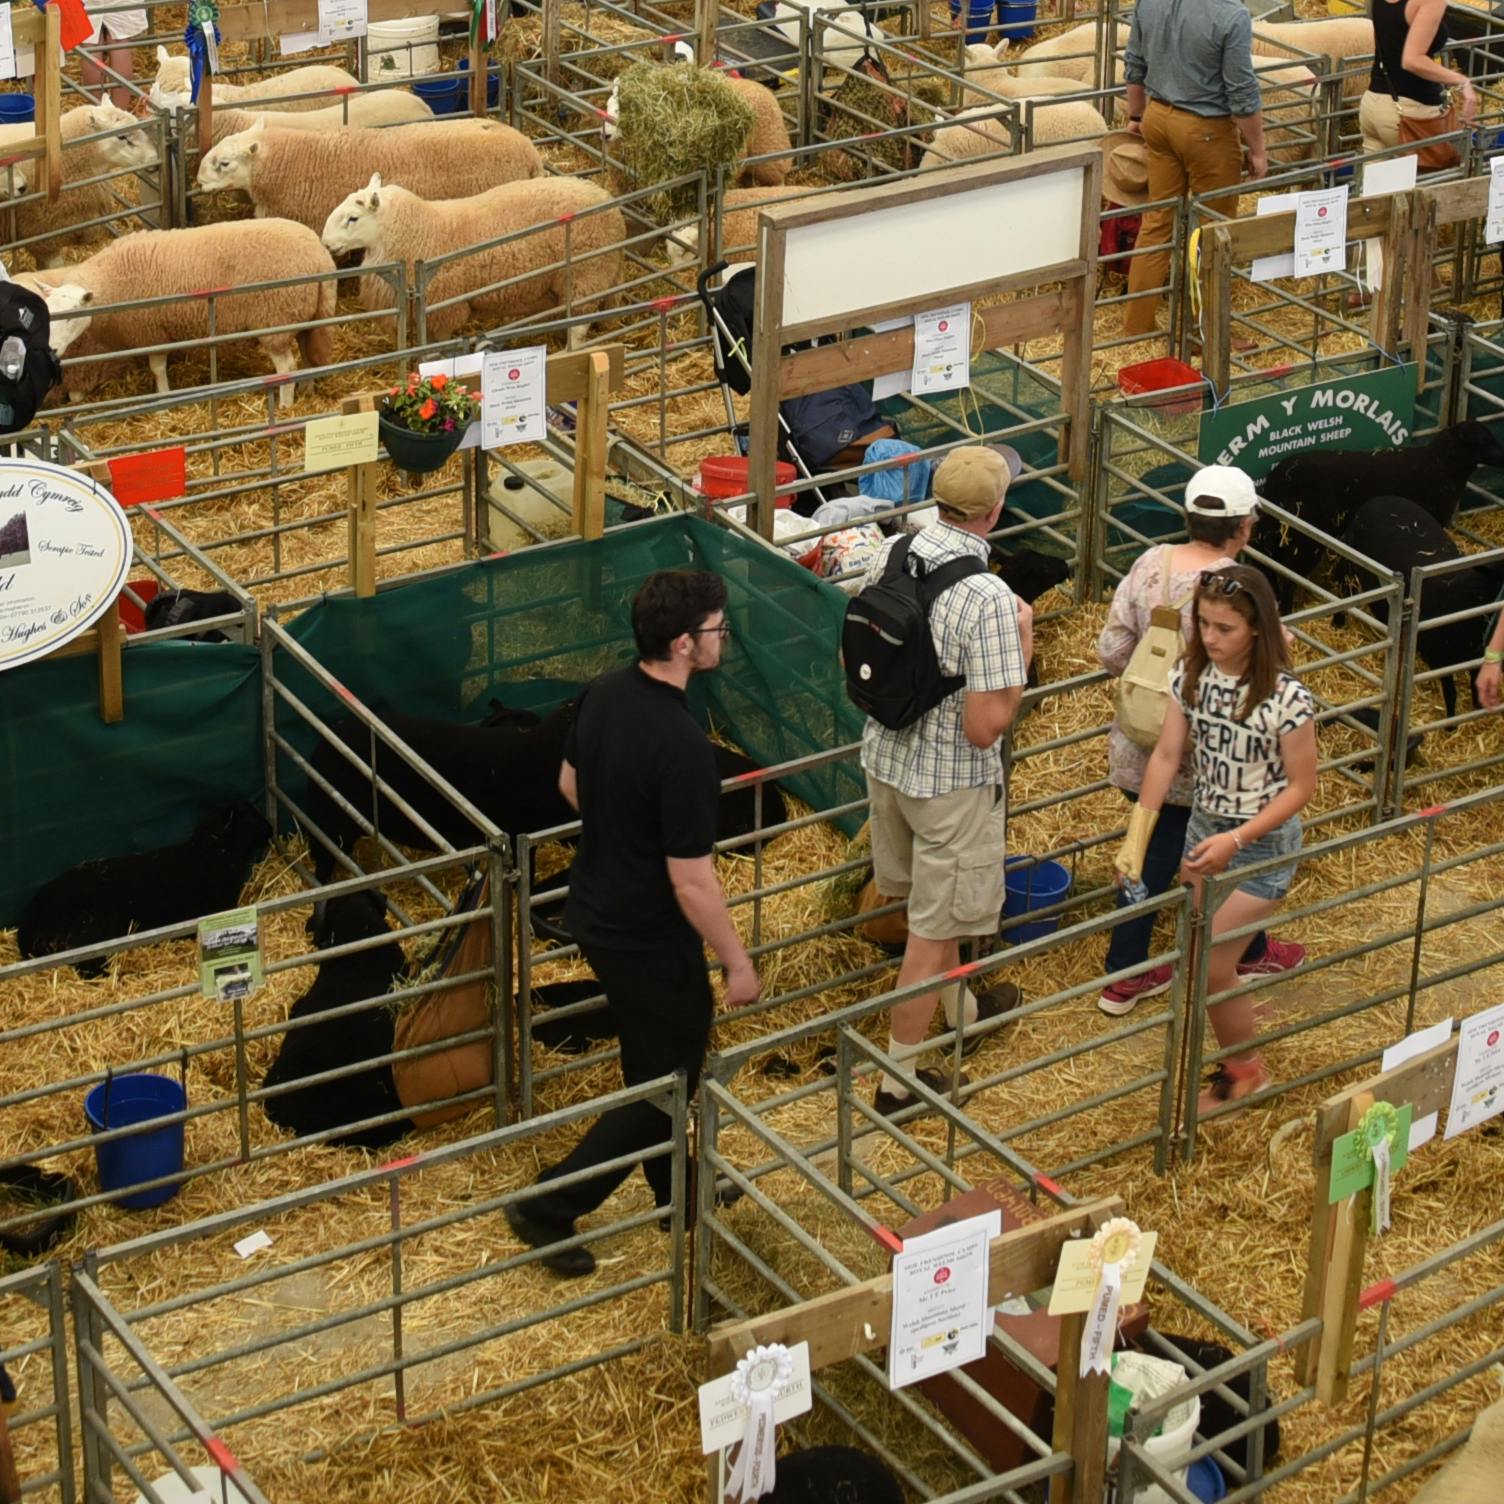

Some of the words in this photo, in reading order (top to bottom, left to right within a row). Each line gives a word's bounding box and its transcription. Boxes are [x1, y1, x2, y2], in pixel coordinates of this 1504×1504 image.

[1281, 396, 1298, 416] Y
[1310, 389, 1409, 446] MORLAIS
[1269, 424, 1302, 441] BLACK
[1307, 415, 1343, 432] WELSH
[1257, 435, 1316, 459] MOUNTAIN
[1320, 427, 1352, 443] SHEEP
[28, 478, 85, 514] Cymreig
[37, 539, 75, 558] Scrapie
[78, 543, 106, 558] Tested
[0, 621, 47, 645] Hughes
